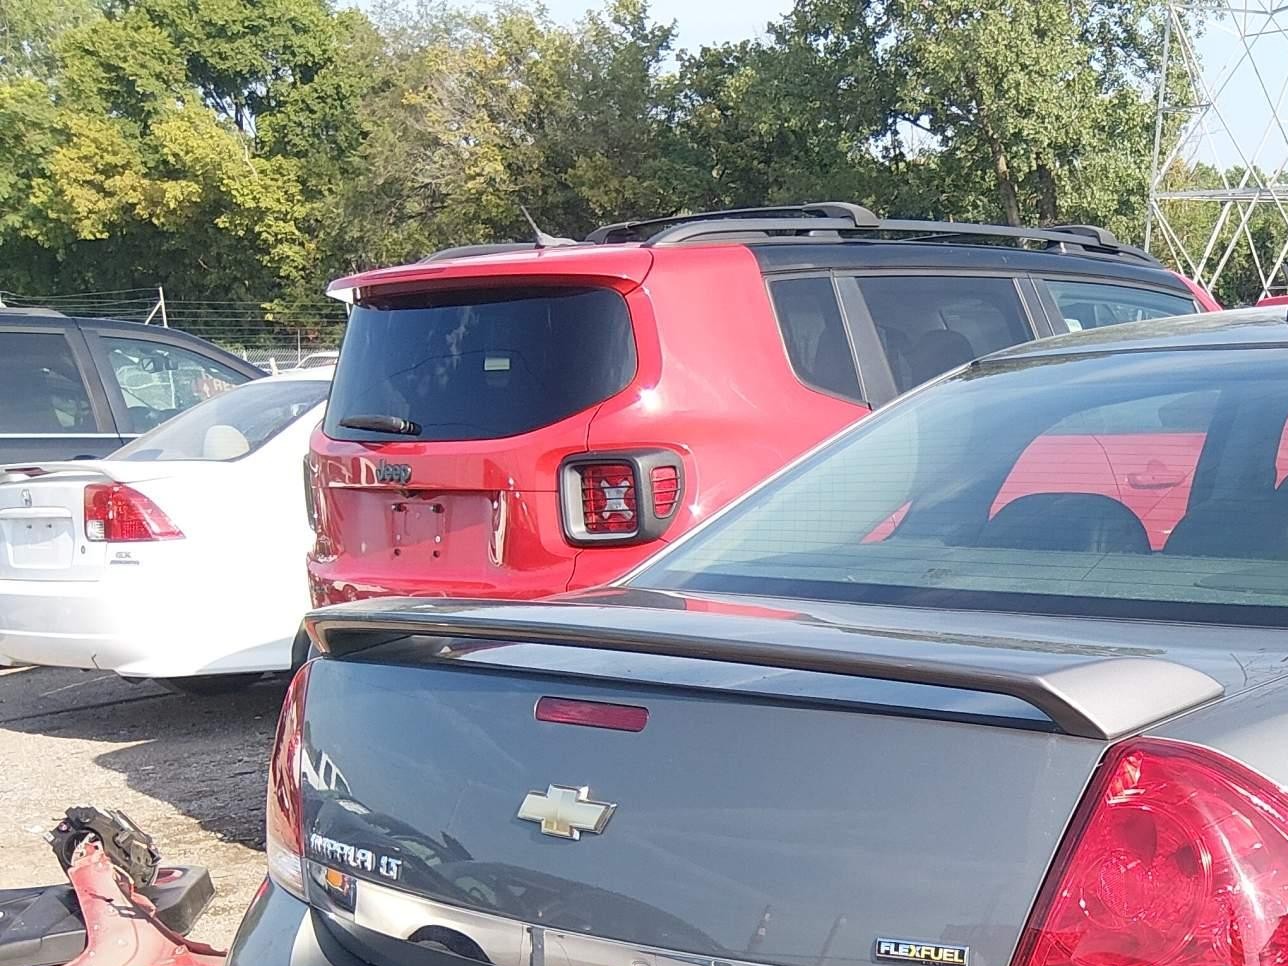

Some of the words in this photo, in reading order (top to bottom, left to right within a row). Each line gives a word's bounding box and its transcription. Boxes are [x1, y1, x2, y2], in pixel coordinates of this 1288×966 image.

[376, 459, 412, 485] Jeep
[310, 833, 373, 871] IMPALA
[379, 855, 402, 881] LT
[880, 941, 964, 963] FLEXFUEL
